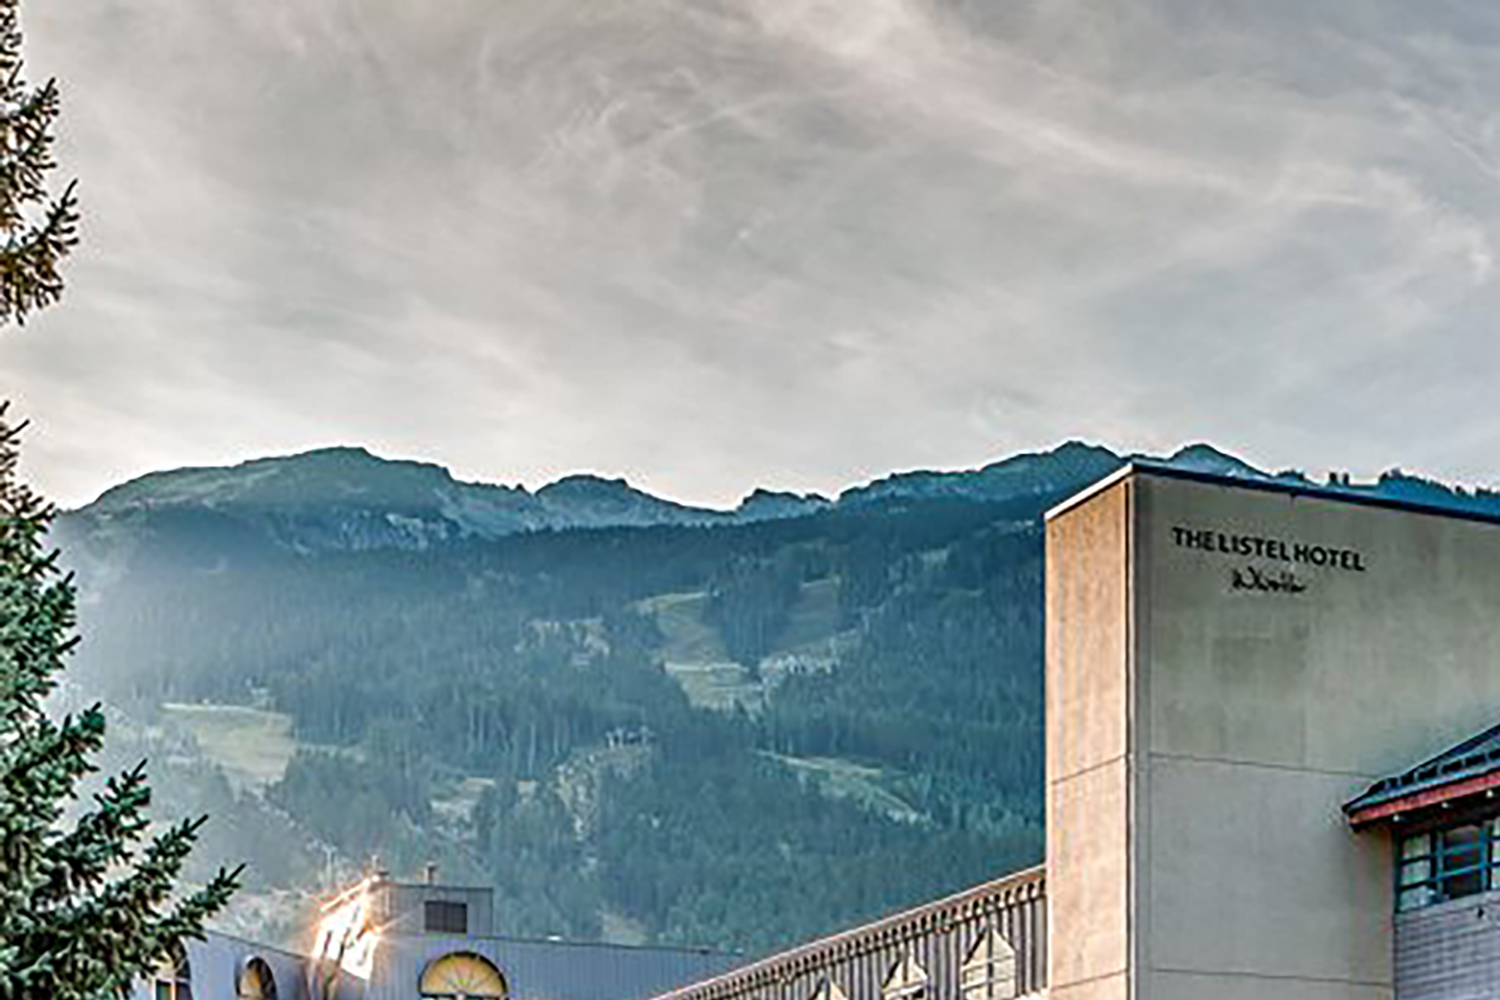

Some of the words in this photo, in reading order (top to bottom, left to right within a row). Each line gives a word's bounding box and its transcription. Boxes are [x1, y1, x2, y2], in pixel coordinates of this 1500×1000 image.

[1172, 526, 1215, 550] THE
[1217, 533, 1291, 562] LISTEL
[1294, 544, 1366, 571] HOTEL
